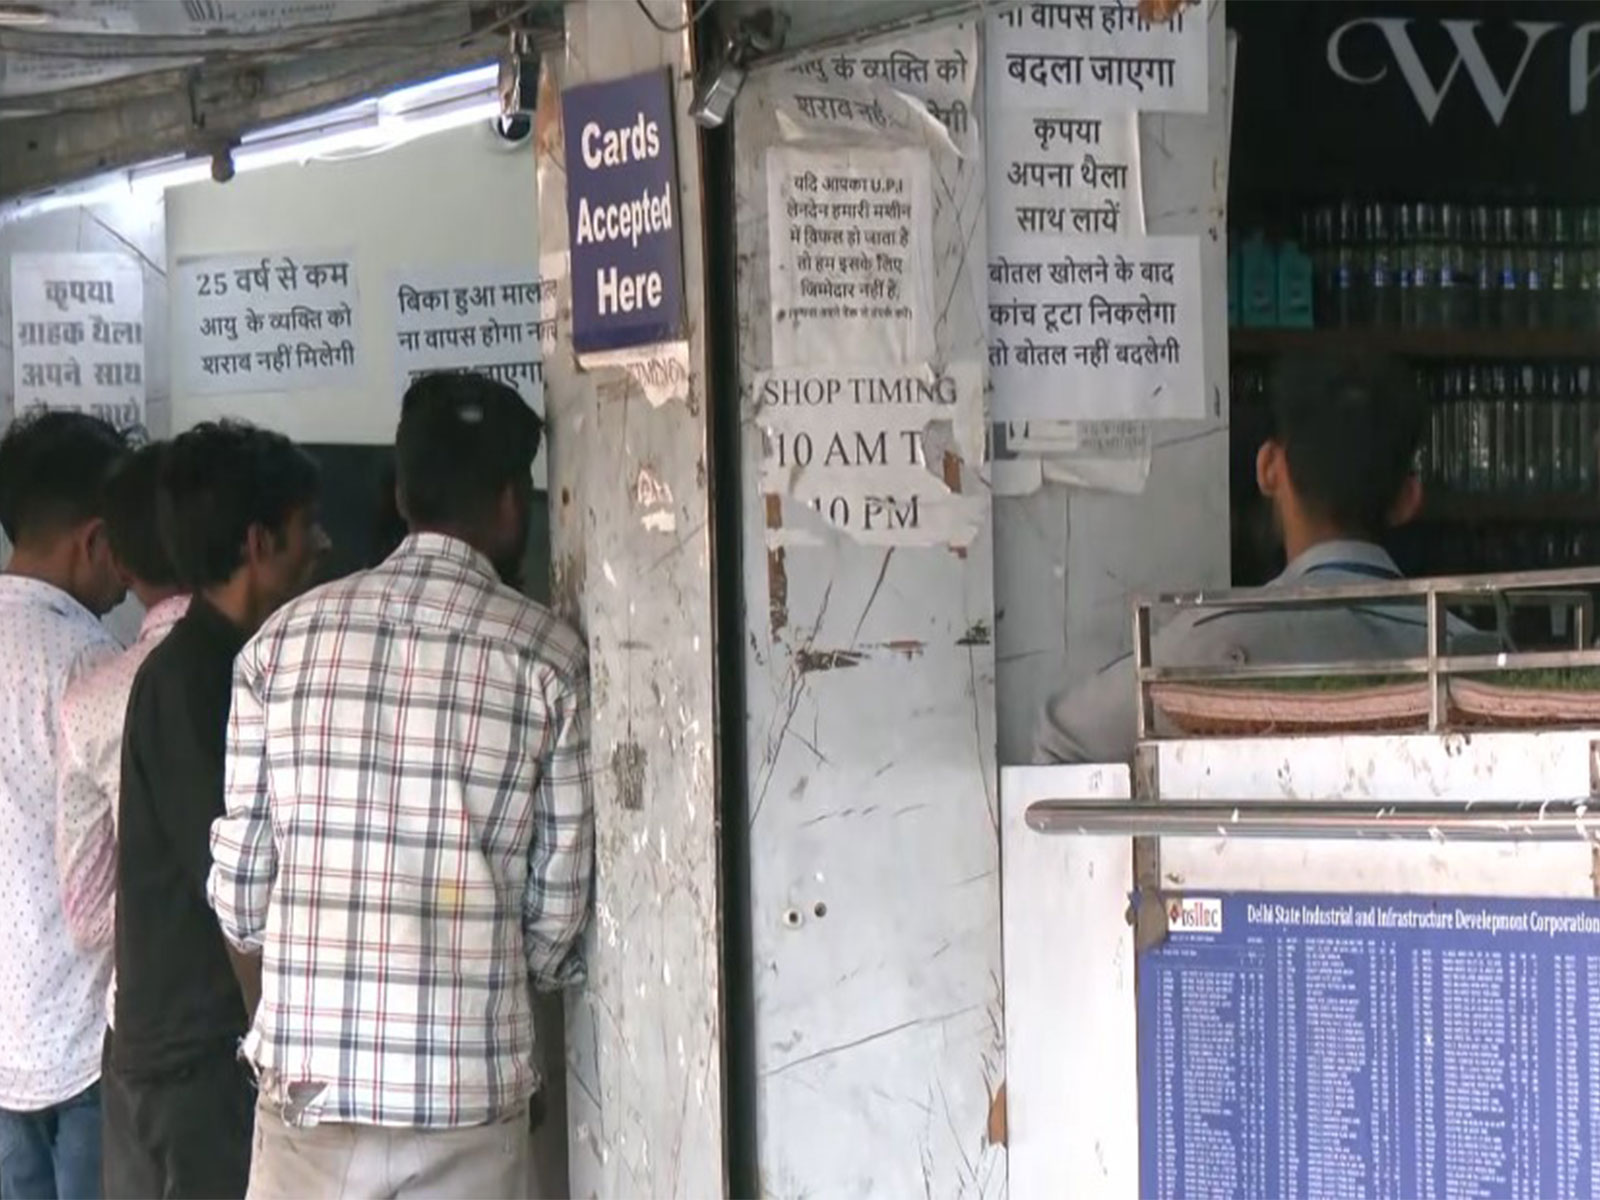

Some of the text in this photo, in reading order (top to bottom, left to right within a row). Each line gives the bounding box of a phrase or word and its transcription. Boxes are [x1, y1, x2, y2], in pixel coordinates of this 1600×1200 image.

[1031, 4, 1095, 30] वापस
[860, 50, 929, 82] व्यक्ति
[934, 50, 968, 83] को
[1006, 53, 1176, 92] बदला जाएगा
[581, 112, 660, 169] Cards
[1032, 117, 1102, 151] कृपया
[822, 177, 867, 193] आपका
[1007, 153, 1129, 190] अपना थैला
[576, 181, 672, 248] Accepted
[1015, 199, 1120, 233] साथ लायें
[197, 256, 349, 297] 25 वर्ष से कम
[987, 254, 1175, 285] बोतल खोलने के बाद
[44, 280, 115, 312] कृपया
[398, 284, 449, 313] बिका
[453, 286, 496, 316] हुआ
[597, 267, 662, 316] Here
[200, 302, 353, 341] आयु के व्यक्ति को
[988, 293, 1177, 334] कांच टूटा निकलेगा
[17, 321, 85, 346] ग्राहक
[397, 330, 419, 351] ना
[424, 325, 476, 350] वापस
[479, 318, 523, 348] होगा
[255, 344, 294, 372] नहीं
[296, 339, 355, 368] मिलेगी
[988, 336, 1180, 369] तो बोतल नहीं बदलेगी
[22, 356, 82, 387] अपने
[764, 376, 957, 406] SHOP TIMING
[776, 430, 926, 467] 10 AM T
[863, 494, 919, 530] PM
[1247, 904, 1274, 924] Delhi
[1275, 905, 1301, 925] State
[1302, 905, 1353, 927] Industrial
[1355, 907, 1375, 927] and
[1377, 906, 1453, 929] Infrastructure
[1530, 911, 1600, 938] Corporation
